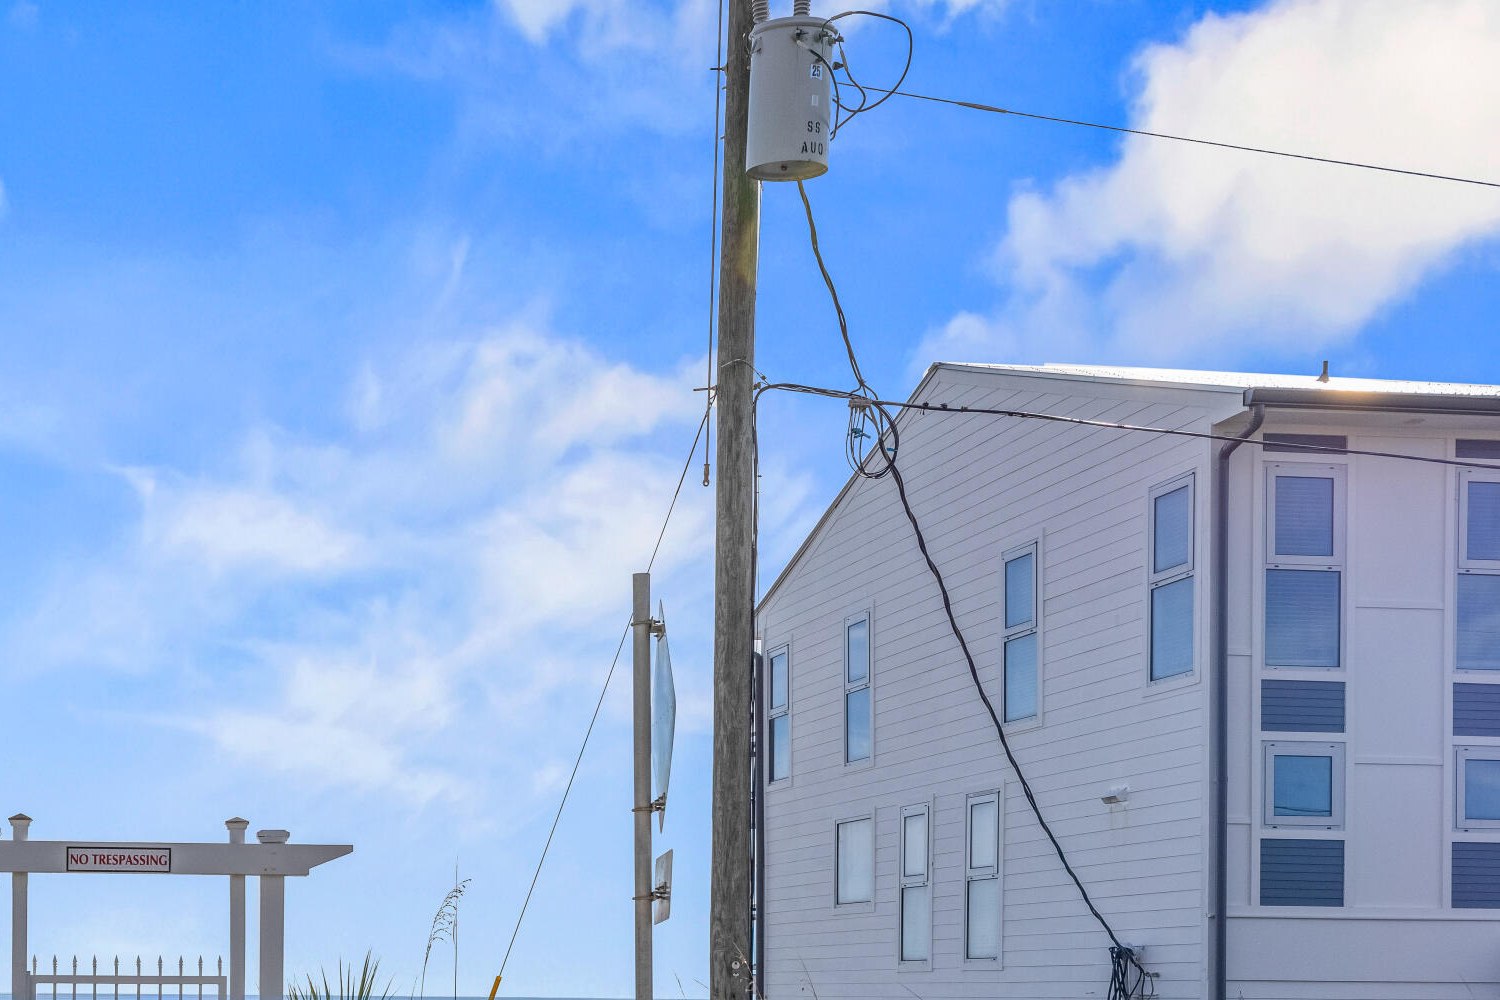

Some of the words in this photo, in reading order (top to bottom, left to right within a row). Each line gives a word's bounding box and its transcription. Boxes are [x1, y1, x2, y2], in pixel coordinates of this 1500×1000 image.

[812, 64, 821, 78] 25
[70, 853, 89, 865] NO
[92, 854, 168, 866] TRESPASSING
